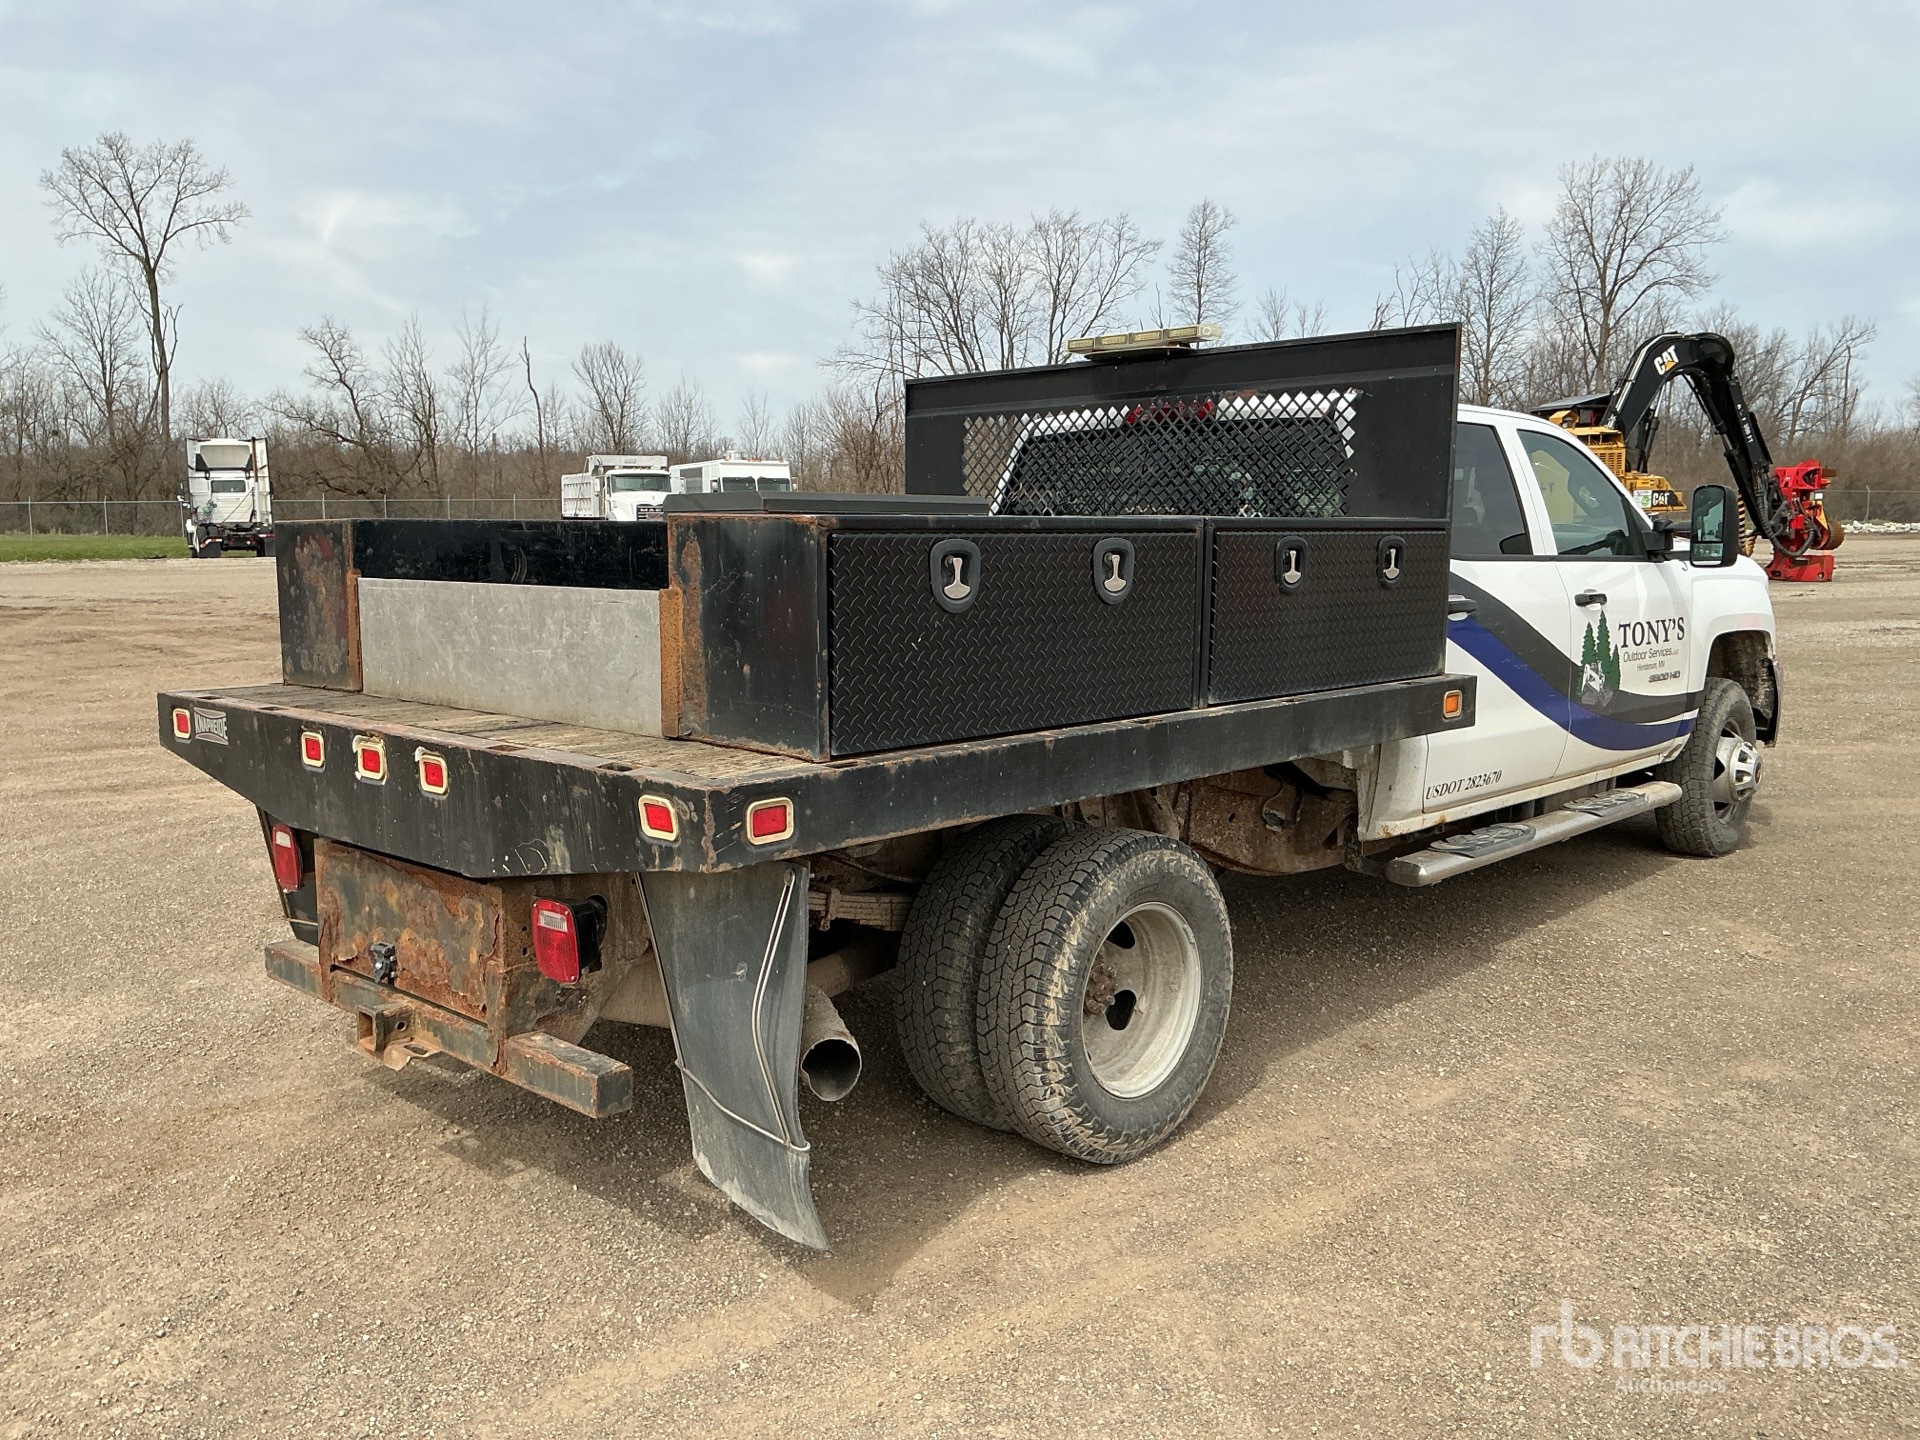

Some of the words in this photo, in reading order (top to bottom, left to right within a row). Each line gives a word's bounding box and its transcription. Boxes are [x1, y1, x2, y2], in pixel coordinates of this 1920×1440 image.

[1653, 344, 1679, 376] CAT
[1618, 616, 1685, 648] TONY'S
[1426, 779, 1465, 800] USDOT
[1464, 769, 1503, 791] 2823670
